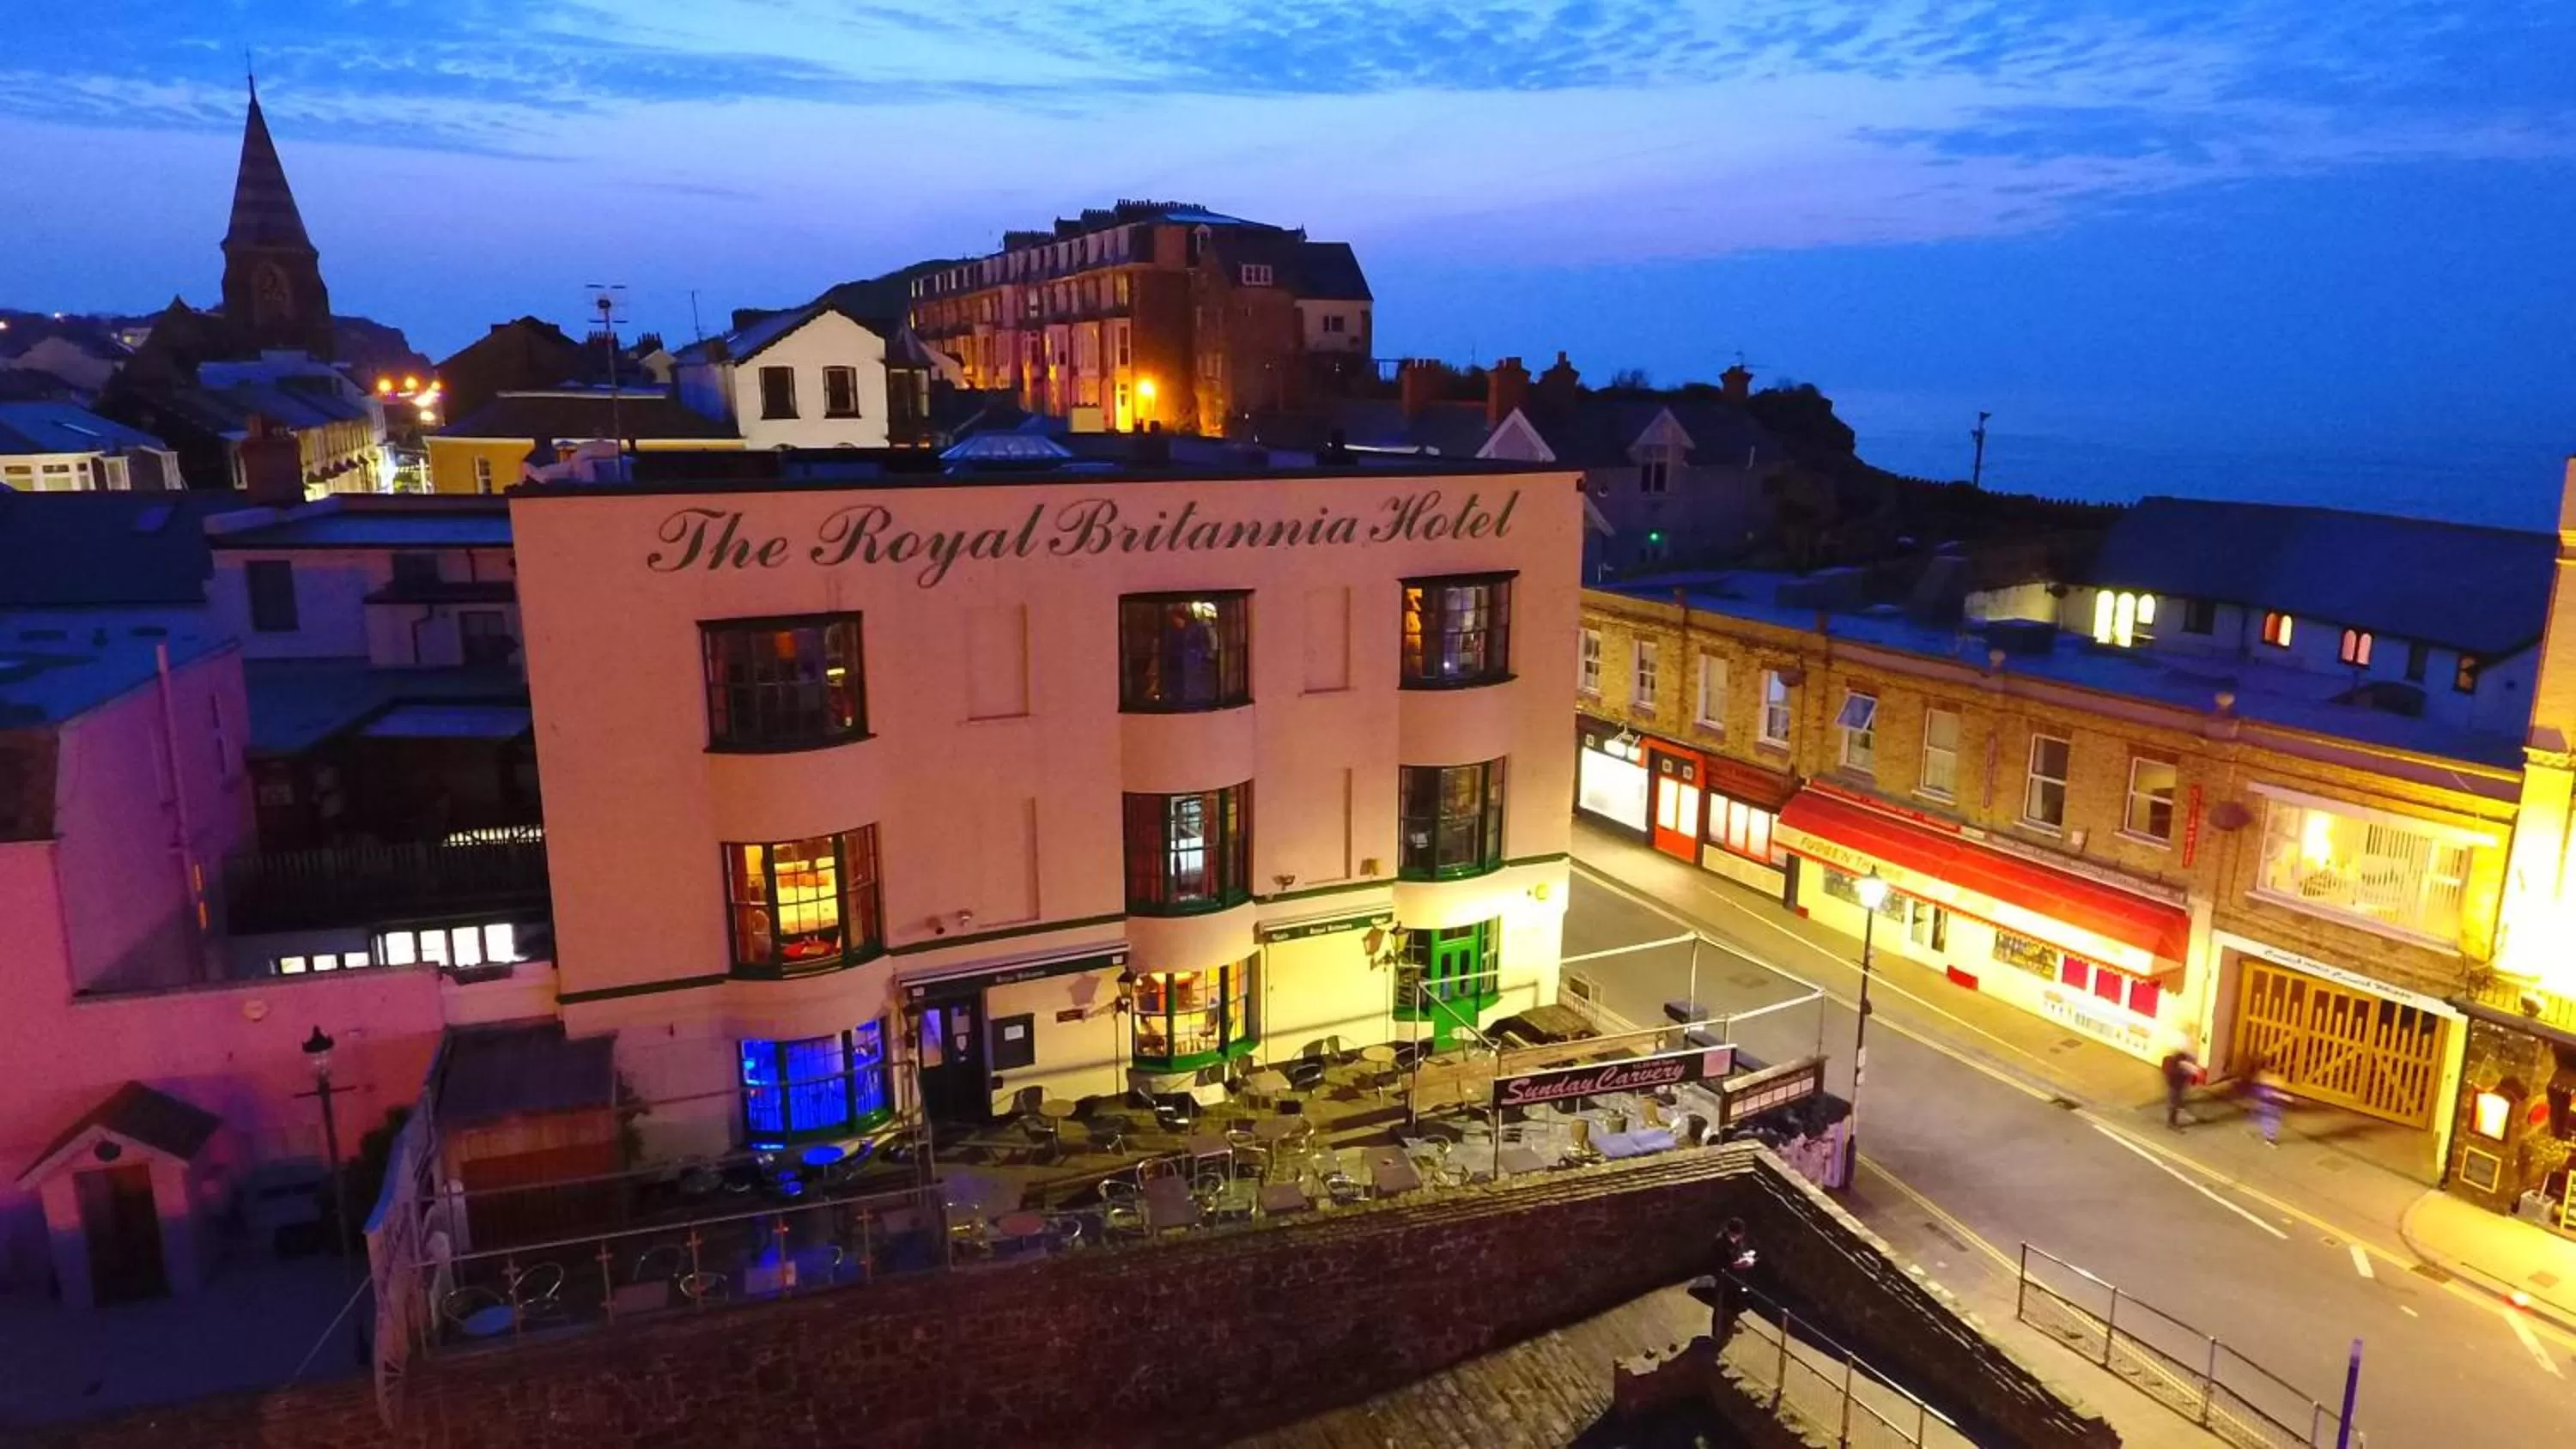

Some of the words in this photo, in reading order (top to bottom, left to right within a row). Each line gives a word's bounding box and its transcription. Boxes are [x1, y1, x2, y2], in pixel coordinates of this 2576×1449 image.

[647, 507, 790, 572] The
[810, 504, 1045, 589] Royal
[1048, 497, 1358, 556] Britannia
[1369, 489, 1521, 543] Hotel
[1503, 1076, 1595, 1104] Sunday
[1595, 1064, 1686, 1090] Carvery
